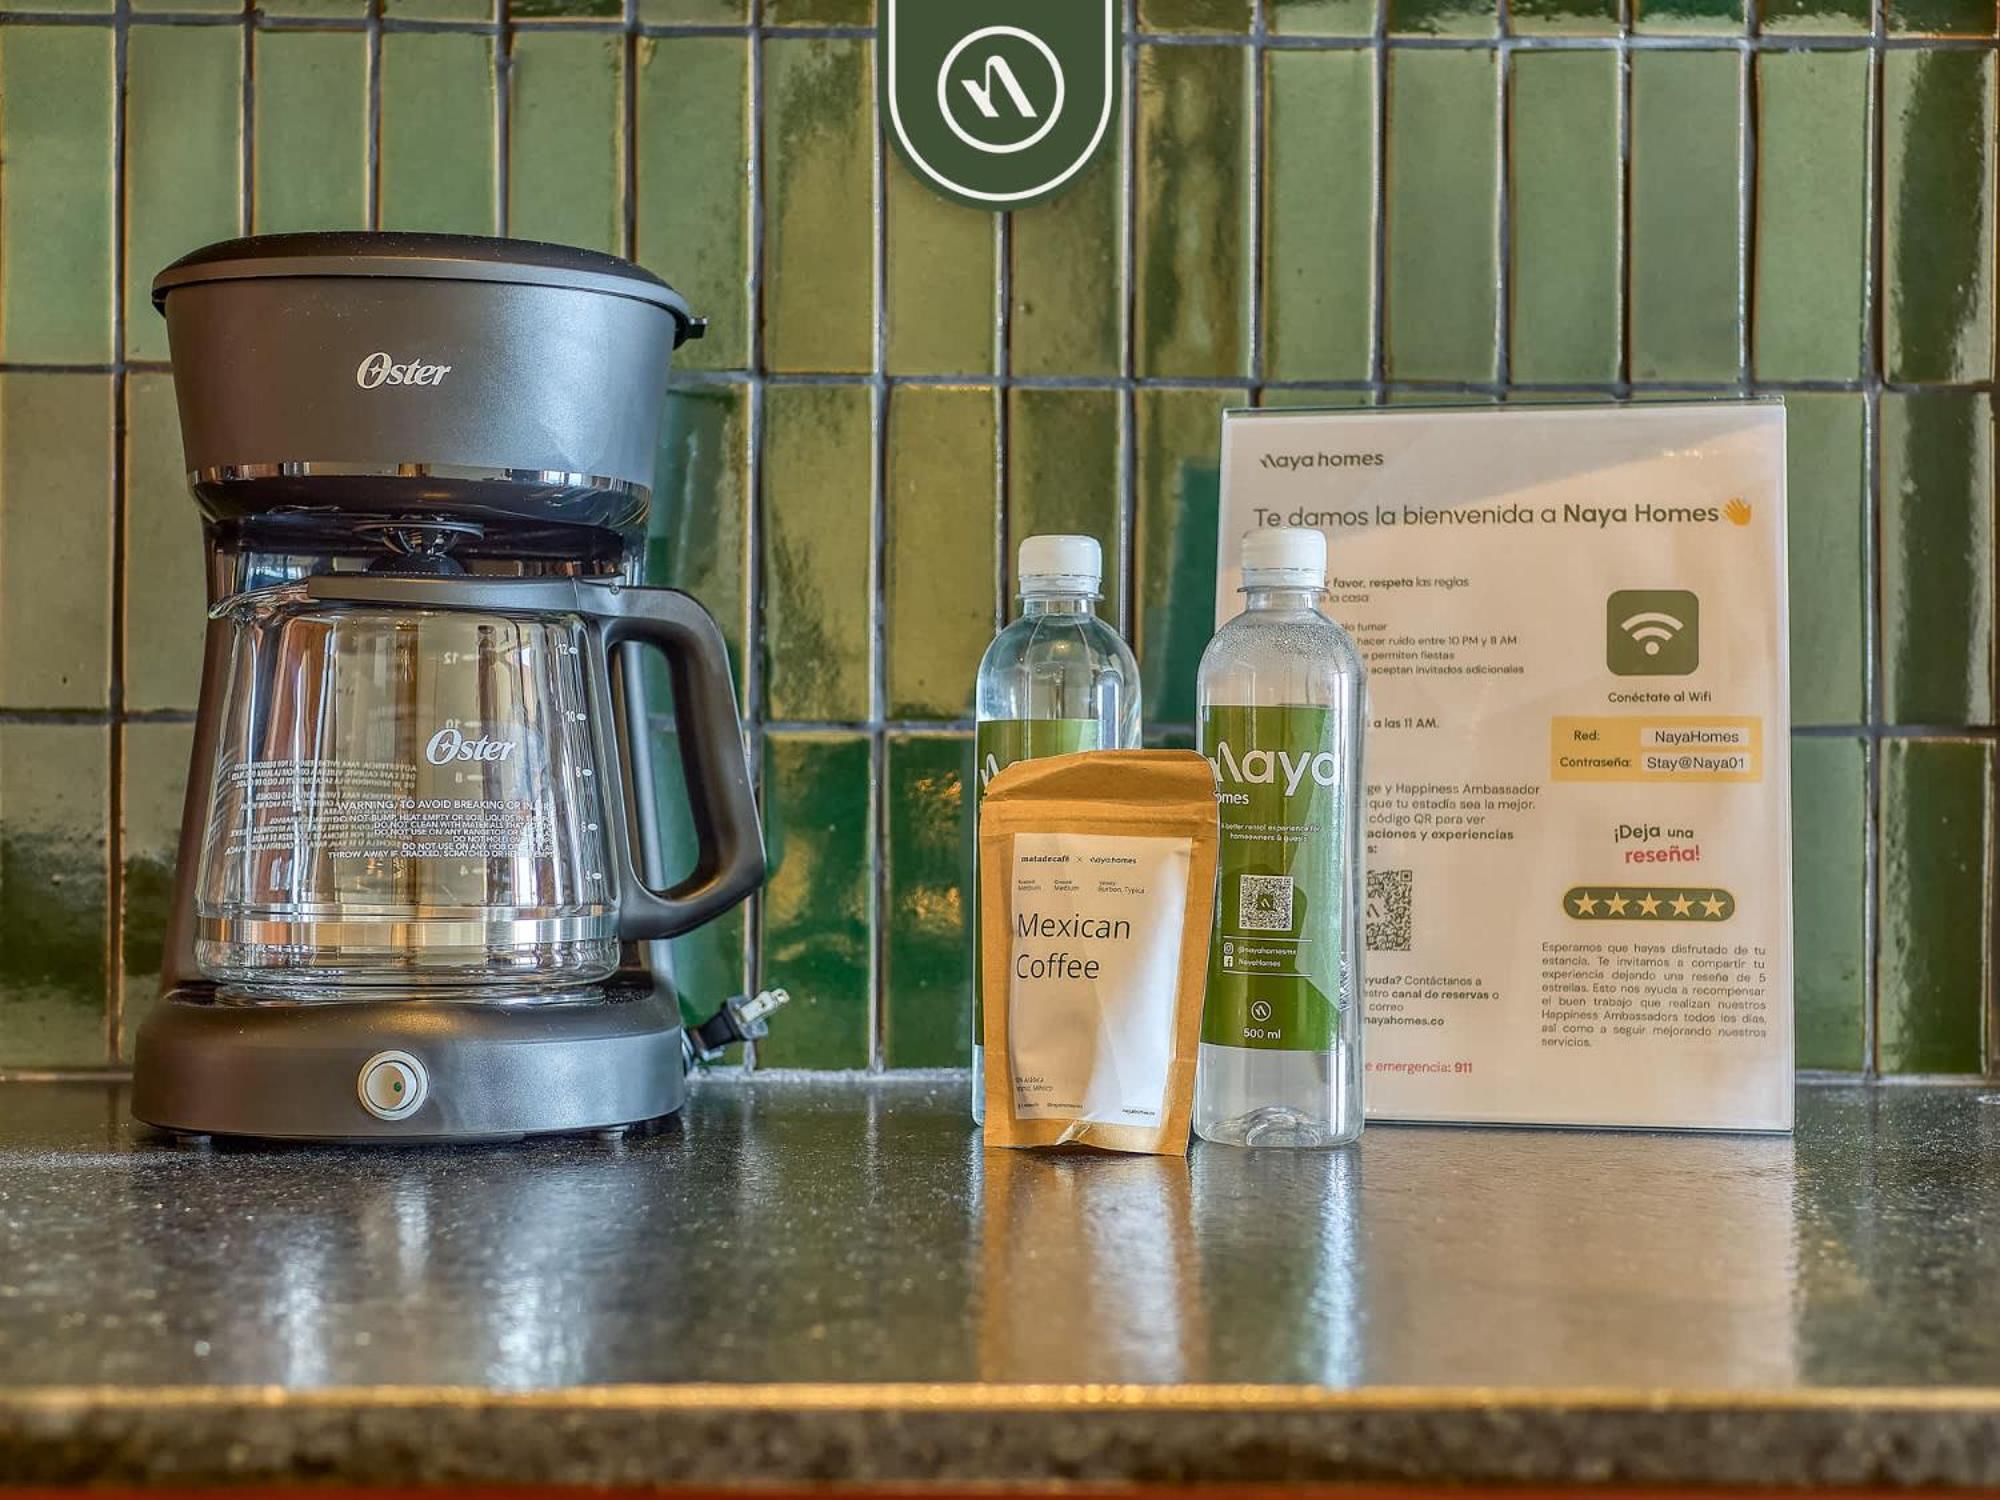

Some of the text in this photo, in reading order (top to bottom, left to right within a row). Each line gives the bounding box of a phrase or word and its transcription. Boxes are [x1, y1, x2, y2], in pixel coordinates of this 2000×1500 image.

[357, 352, 451, 389] Oster
[1317, 452, 1385, 467] homes
[1253, 504, 1720, 528] Te damos la bienvenida a Naya Homes
[1369, 579, 1414, 590] respeta
[1415, 577, 1432, 587] las
[1433, 577, 1470, 590] reglas
[1356, 622, 1387, 631] fumar
[1356, 635, 1518, 646] hacer ruido entre 10 PM y 8 AM
[1370, 650, 1455, 661] permiten fiestas
[1370, 664, 1525, 675] aceptan invitados adicionales
[1607, 691, 1713, 703] Conéctate al Wifi
[1373, 719, 1382, 728] a
[1383, 717, 1401, 728] las
[1403, 717, 1414, 728] 11
[1573, 730, 1740, 745] Red: NayaHomes
[427, 729, 516, 766] Oster
[1559, 757, 1745, 772] Contraseña: Stay@Naya01
[1384, 784, 1541, 795] y Happiness Ambassador
[399, 799, 416, 808] TO
[417, 799, 452, 808] AVOID
[454, 799, 505, 809] BREAKING
[1215, 793, 1250, 804] omes
[1396, 799, 1409, 808] tu
[1411, 799, 1457, 809] estadía
[1459, 800, 1481, 809] sea
[1484, 799, 1495, 809] la
[1497, 800, 1536, 812] mejor.
[374, 820, 389, 828] DO
[1368, 813, 1486, 826] código QR para ver
[1367, 828, 1515, 842] aciones y experiencias
[1614, 824, 1695, 843] ¡Deja una
[327, 850, 362, 858] THROW
[362, 850, 389, 858] AWAY
[1020, 854, 1071, 862] matadecafé
[1624, 845, 1701, 863] reseña!
[1017, 913, 1131, 939] Mexican
[1541, 942, 1766, 955] Esperamos que hayas disfrutado de tu
[1016, 953, 1100, 979] Coffee
[1541, 956, 1591, 966] estancia.
[1598, 956, 1610, 966] Te
[1616, 955, 1671, 966] invitamos
[1691, 959, 1747, 970] compartir
[1753, 959, 1766, 969] tu
[1403, 975, 1473, 986] Contáctanos
[1474, 978, 1483, 986] a
[1541, 969, 1767, 982] experiencia dejando una reseña de 5
[1391, 989, 1422, 998] canal
[1424, 989, 1439, 999] de
[1441, 990, 1489, 999] reservas
[1592, 982, 1617, 992] Esto
[1644, 984, 1678, 995] ayuda
[1681, 986, 1689, 994] a
[1692, 987, 1766, 997] recompensar
[1368, 1002, 1404, 1011] correo
[1541, 995, 1767, 1009] el buen trabajo que realizan nuestros
[1364, 1015, 1445, 1025] nayahomes.co
[1541, 1009, 1599, 1020] Happiness
[1602, 1010, 1679, 1021] Ambassadors
[1684, 1013, 1716, 1022] todos
[1720, 1013, 1737, 1023] los
[1242, 1027, 1282, 1039] 500 ml
[1562, 1024, 1595, 1033] como
[1612, 1025, 1646, 1036] seguir
[1652, 1026, 1712, 1038] mejorando
[1718, 1028, 1767, 1038] nuestros
[1375, 1061, 1473, 1074] emergencia: 911
